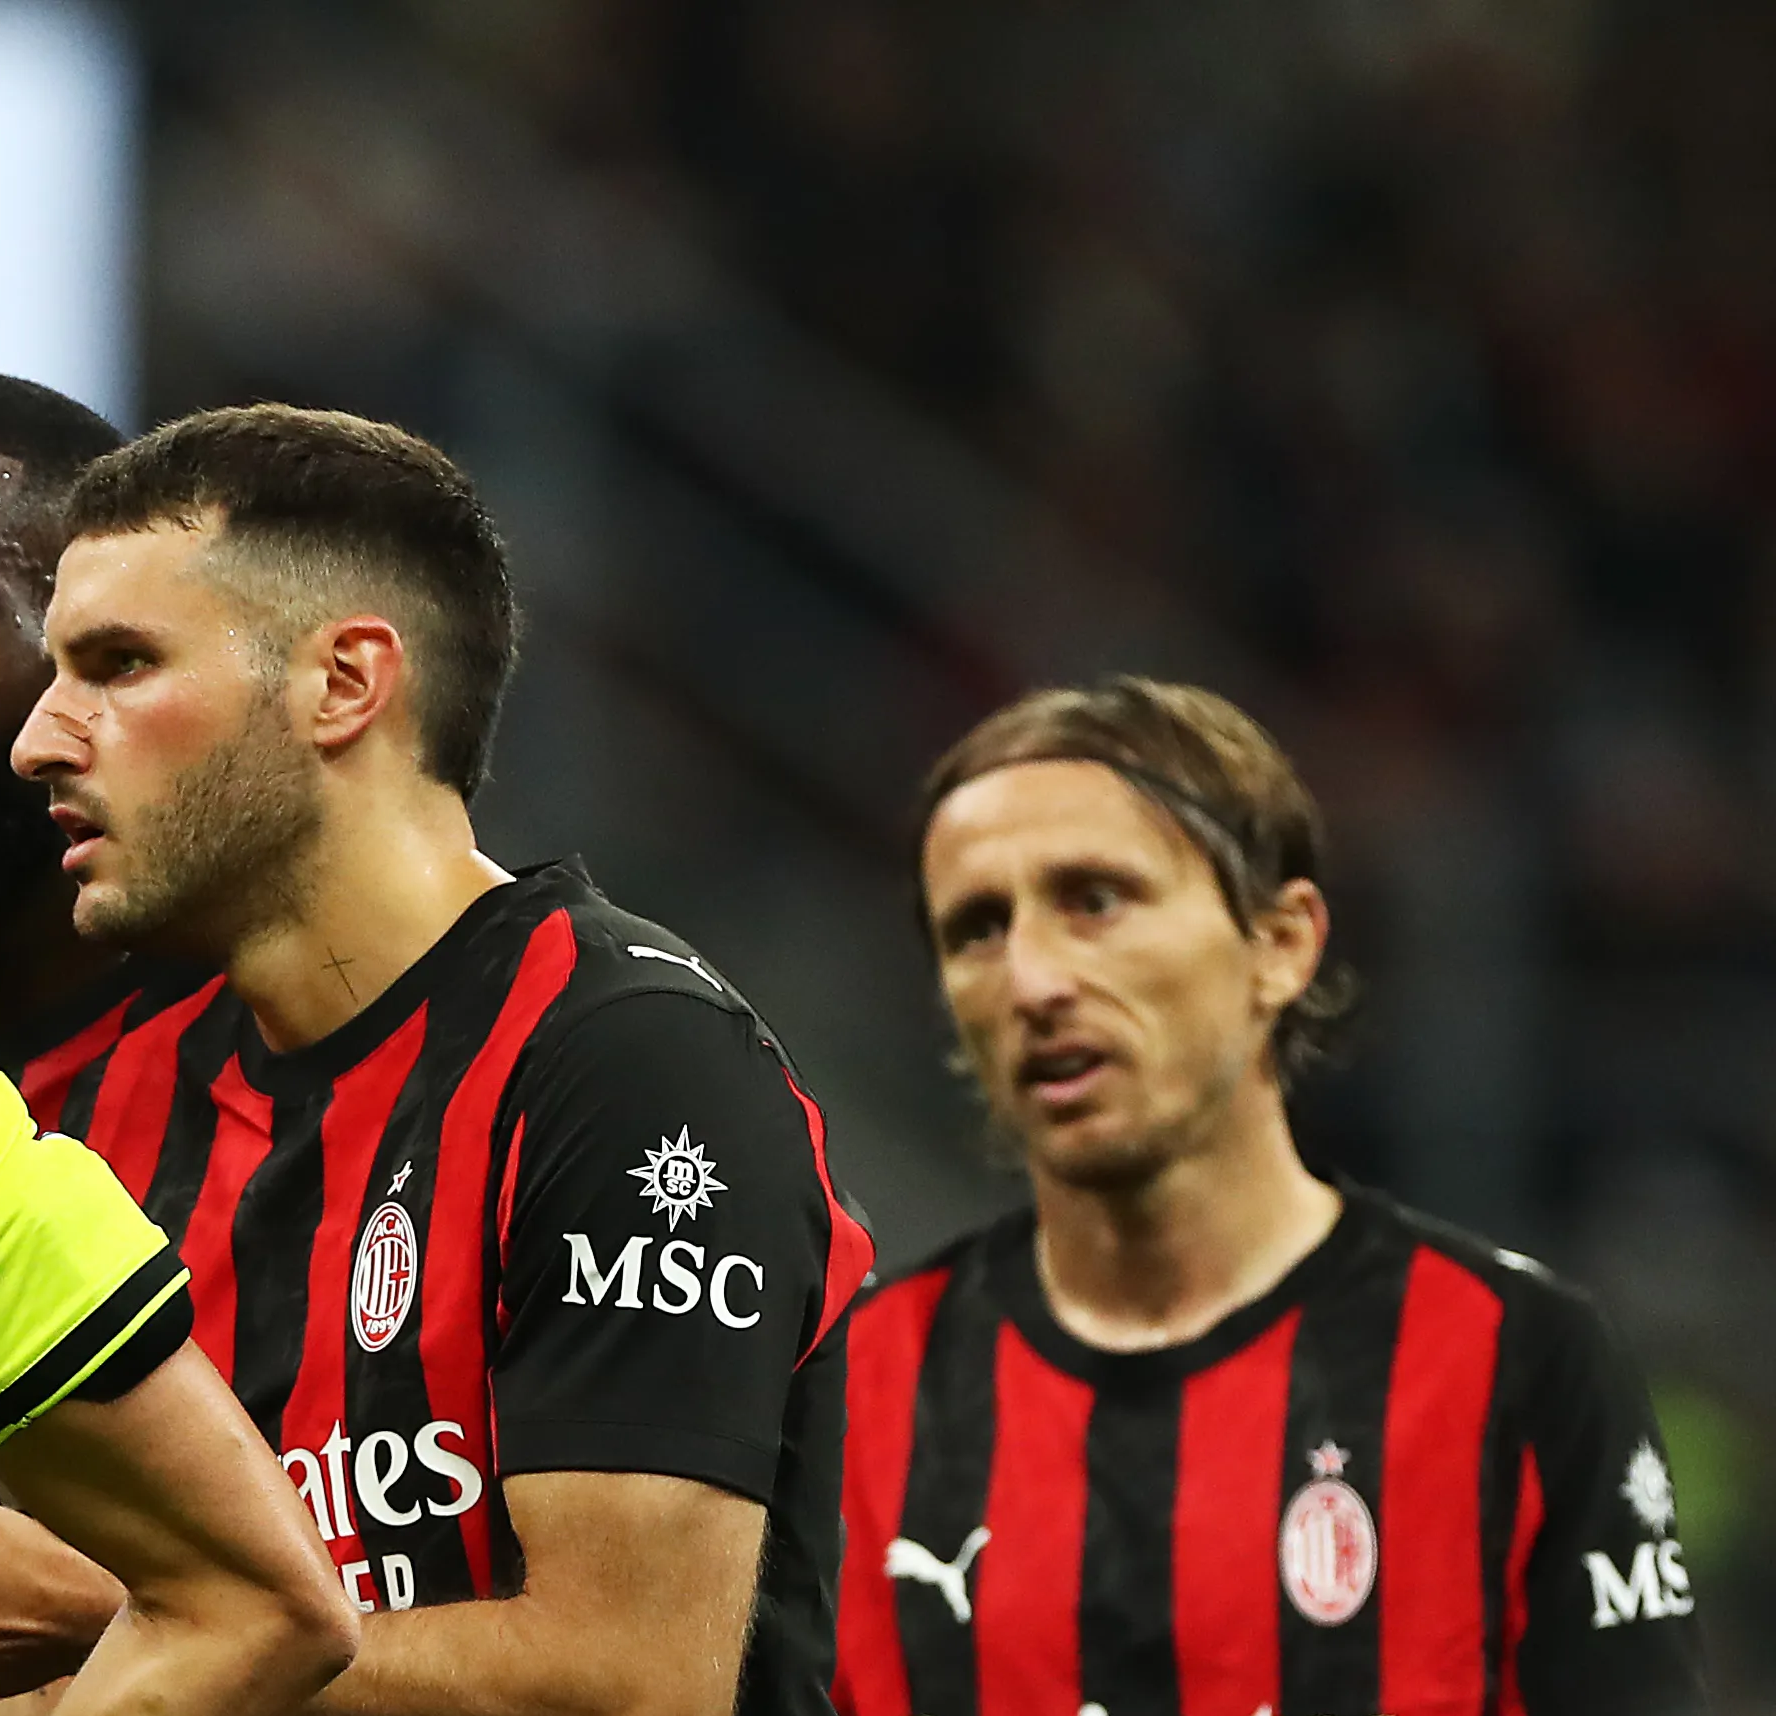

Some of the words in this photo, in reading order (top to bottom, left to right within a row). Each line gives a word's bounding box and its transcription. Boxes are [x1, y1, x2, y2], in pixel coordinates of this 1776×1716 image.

[370, 1215, 406, 1245] ACM
[561, 1232, 764, 1330] MSC
[365, 1315, 396, 1335] 1899
[1581, 1539, 1696, 1630] MS
